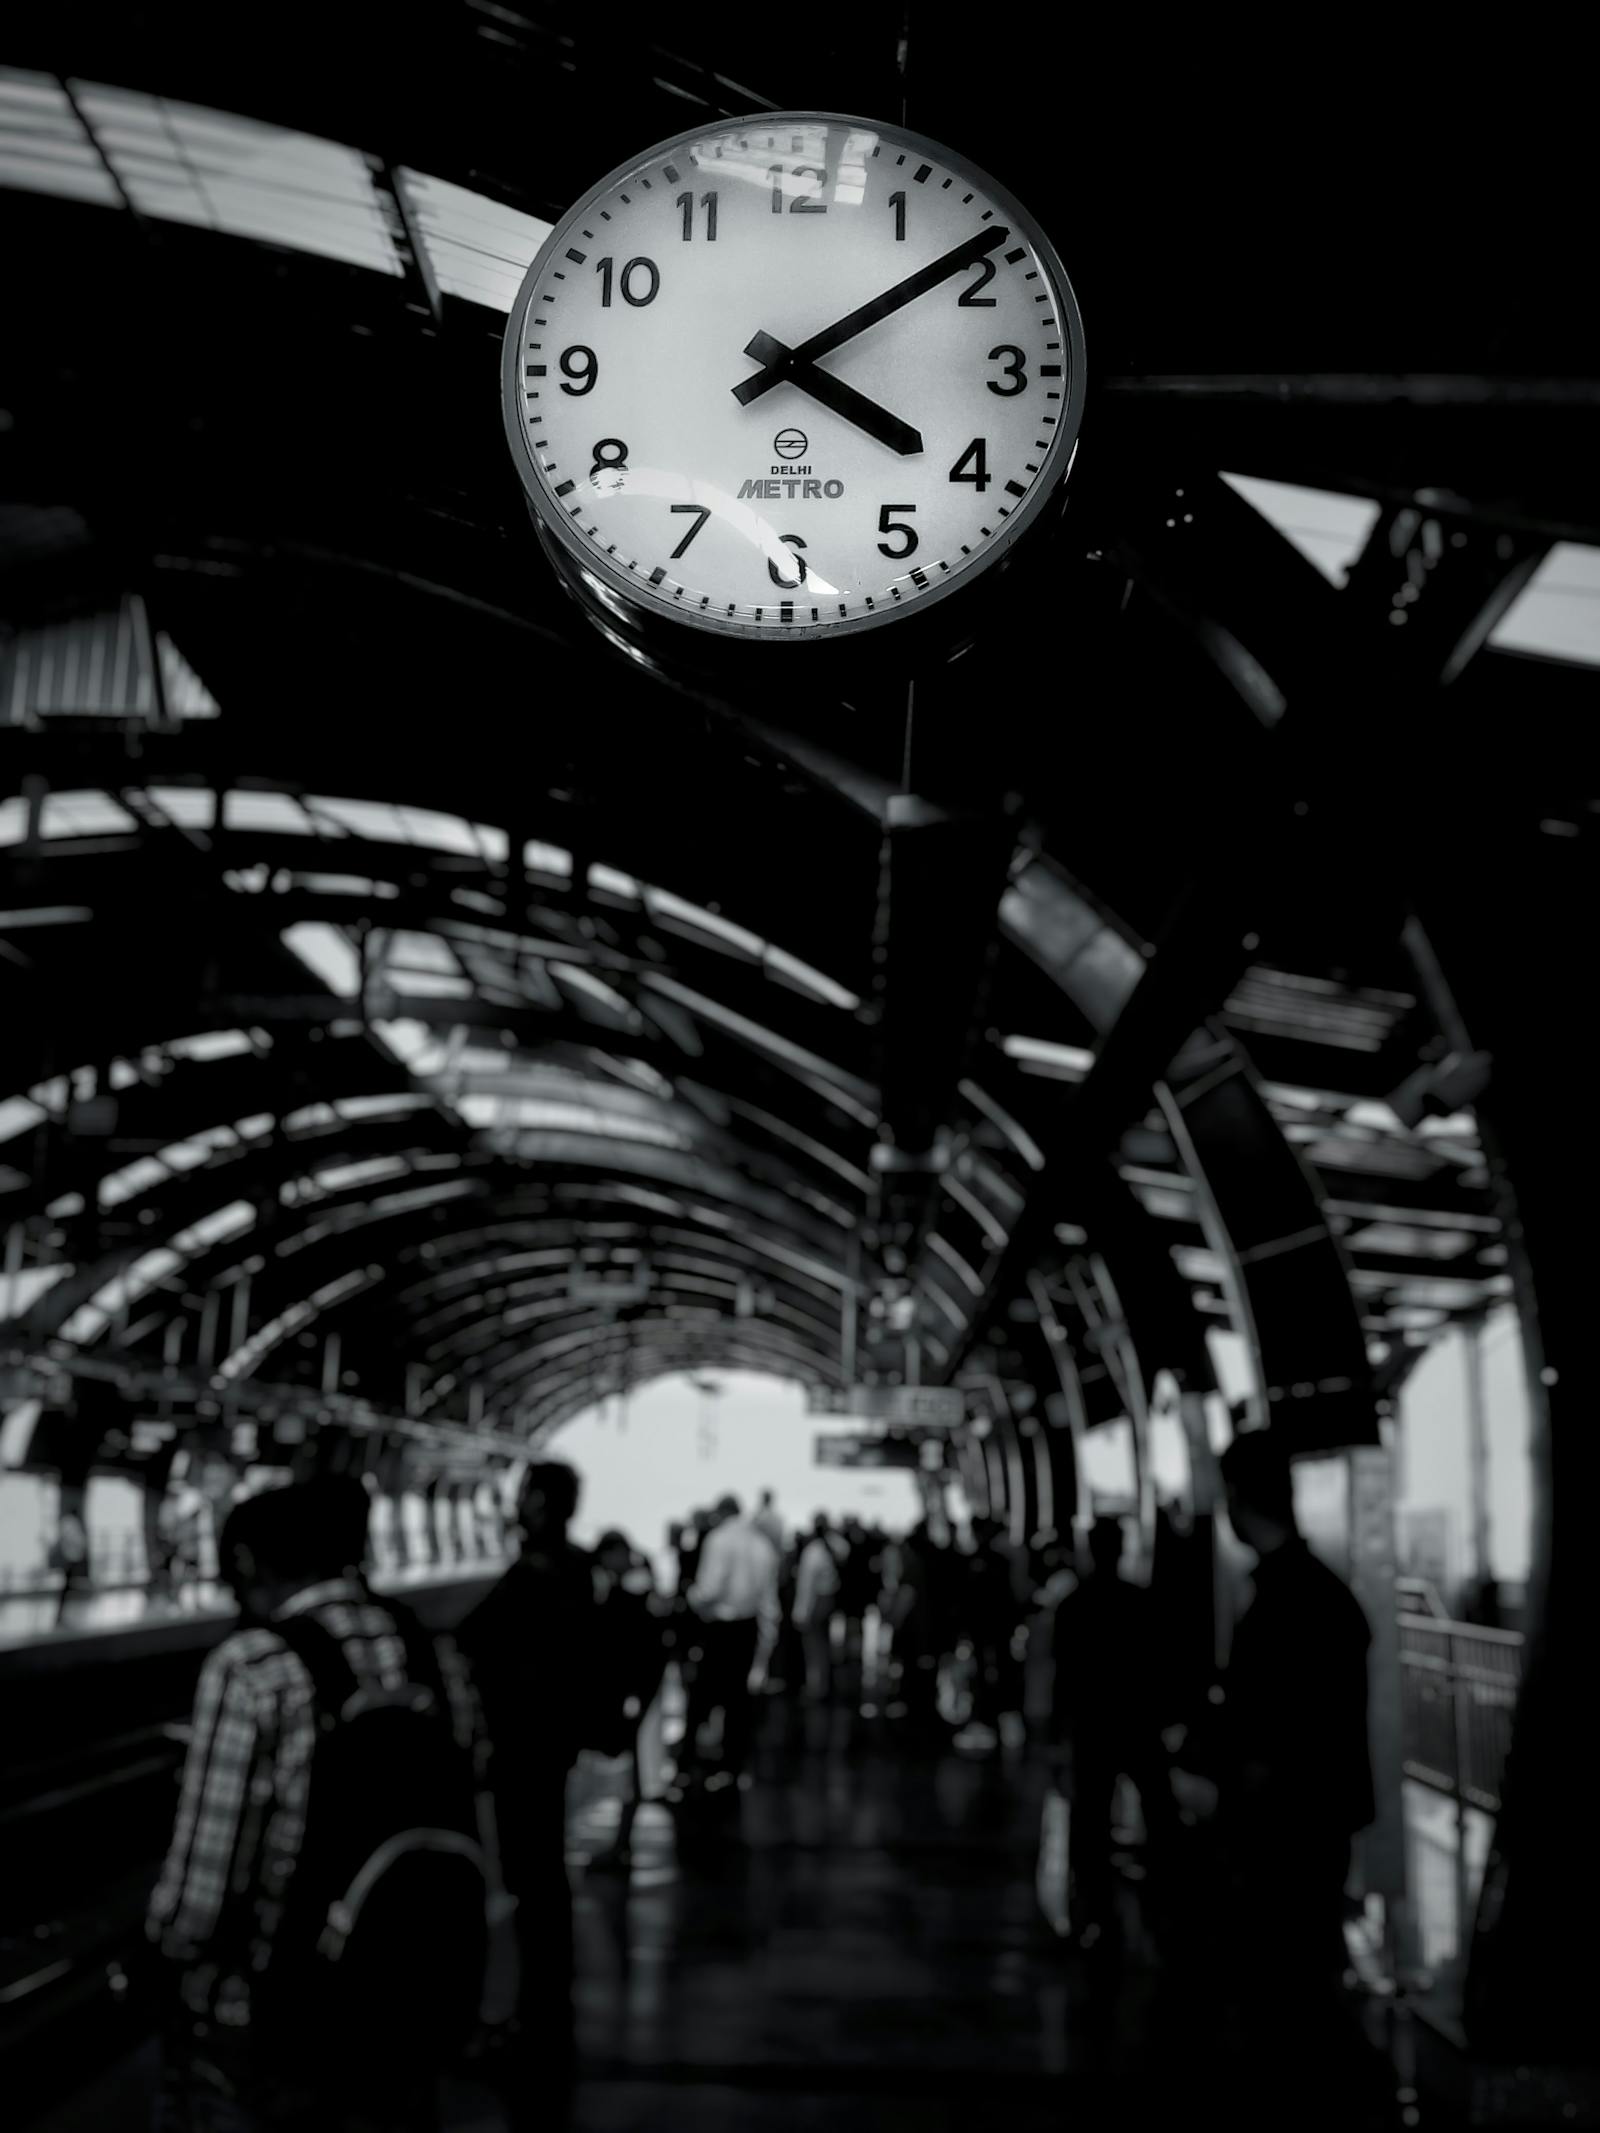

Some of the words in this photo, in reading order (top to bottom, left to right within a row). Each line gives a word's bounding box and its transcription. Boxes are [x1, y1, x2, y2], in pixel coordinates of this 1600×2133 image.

[768, 164, 827, 214] 12
[677, 191, 717, 241] 11
[889, 191, 906, 241] 1
[596, 257, 660, 307] 10
[957, 257, 997, 307] 2
[559, 345, 599, 396] 9
[986, 345, 1027, 396] 3
[737, 479, 844, 499] METRO
[769, 465, 813, 476] DELHI
[949, 438, 991, 492] 4
[670, 505, 711, 559] 7
[877, 505, 919, 559] 5
[768, 534, 807, 588] 6
